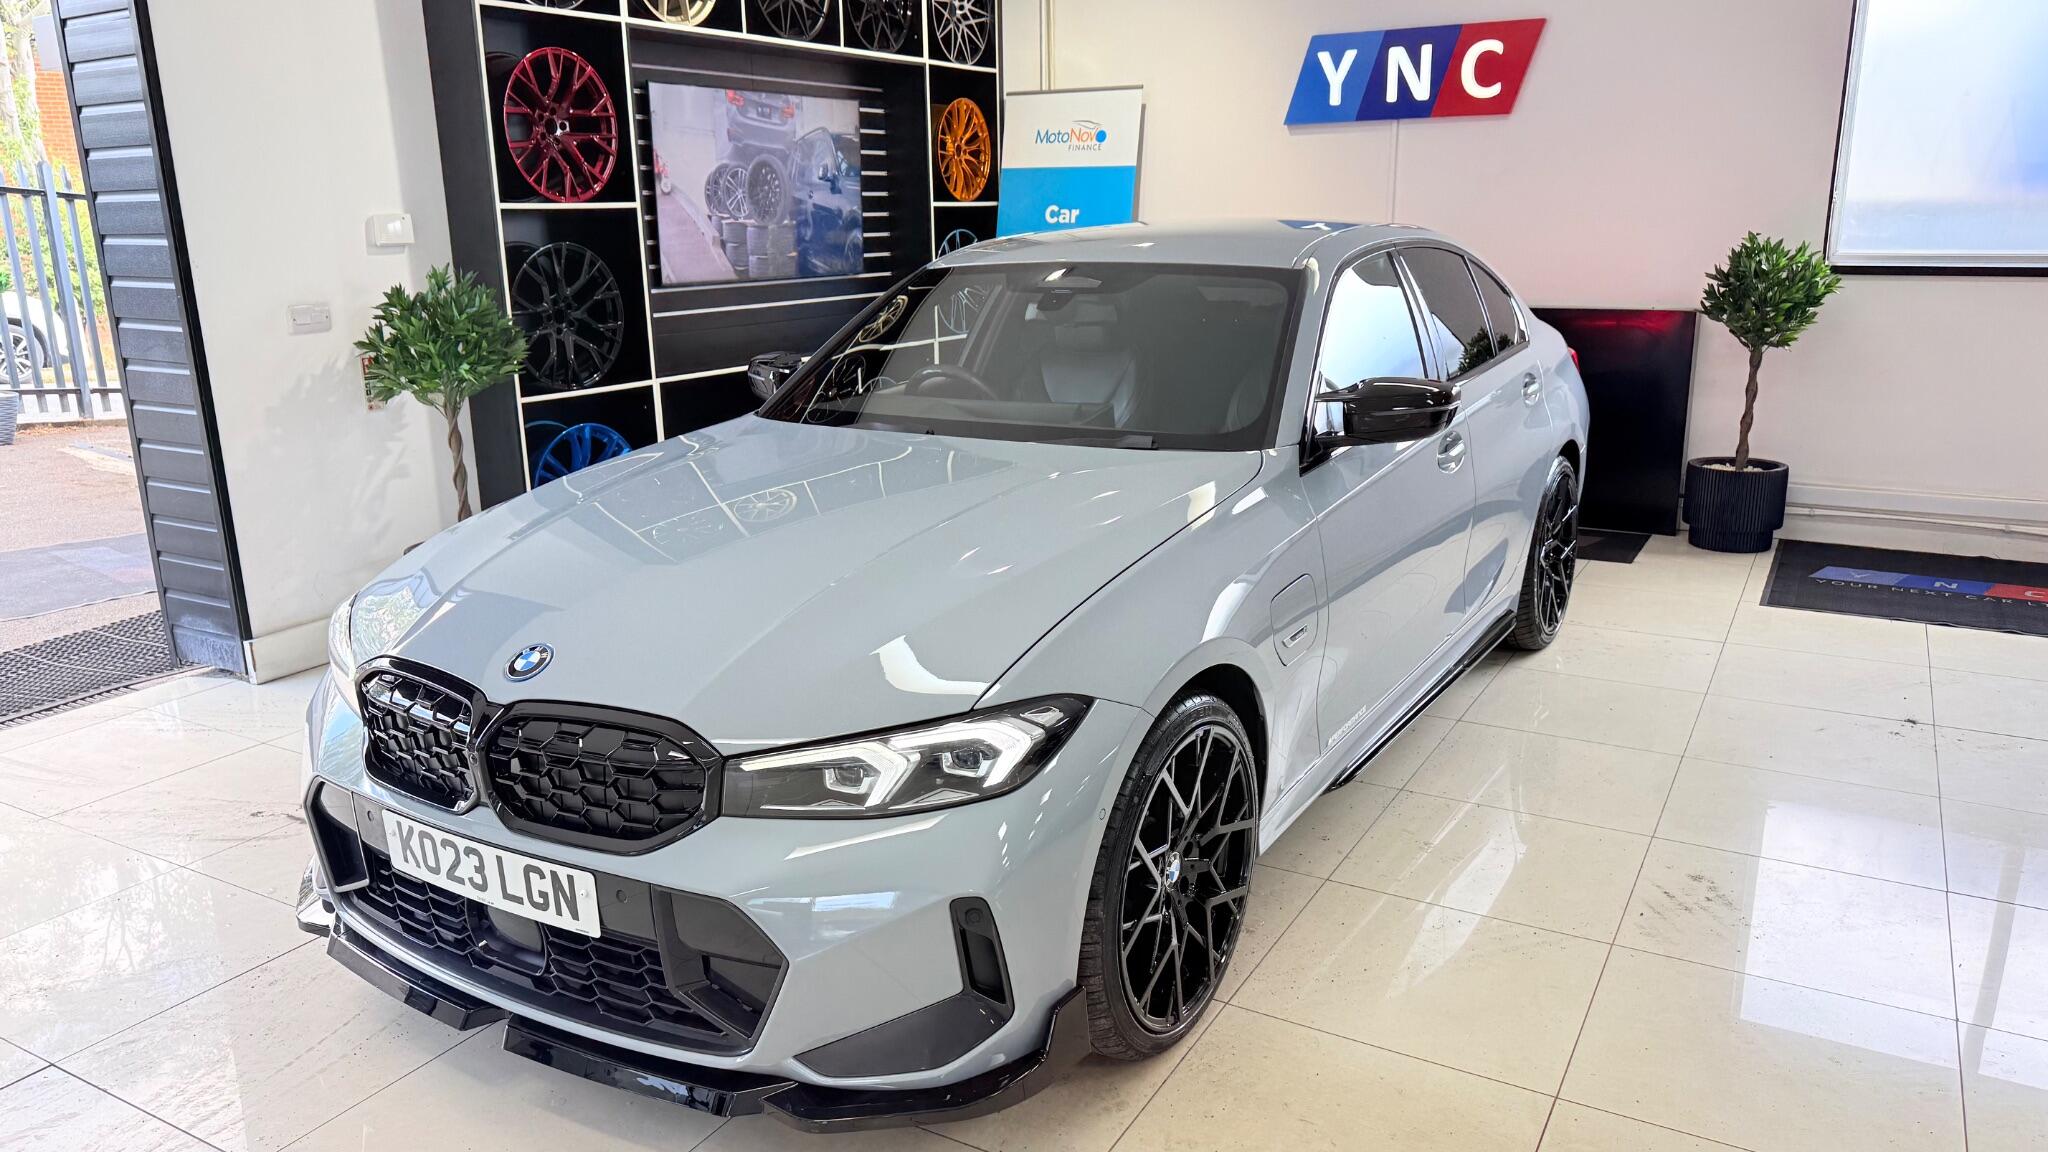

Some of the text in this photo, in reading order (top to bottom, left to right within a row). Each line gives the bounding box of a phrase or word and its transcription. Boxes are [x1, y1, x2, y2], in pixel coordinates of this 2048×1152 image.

[1317, 39, 1504, 106] YNC
[1067, 143, 1102, 152] FINANCE
[1045, 204, 1080, 224] Car
[1816, 579, 1878, 589] YOUR
[1891, 587, 1952, 597] NEXT
[1965, 595, 2013, 603] CAR
[496, 854, 580, 922] LGN
